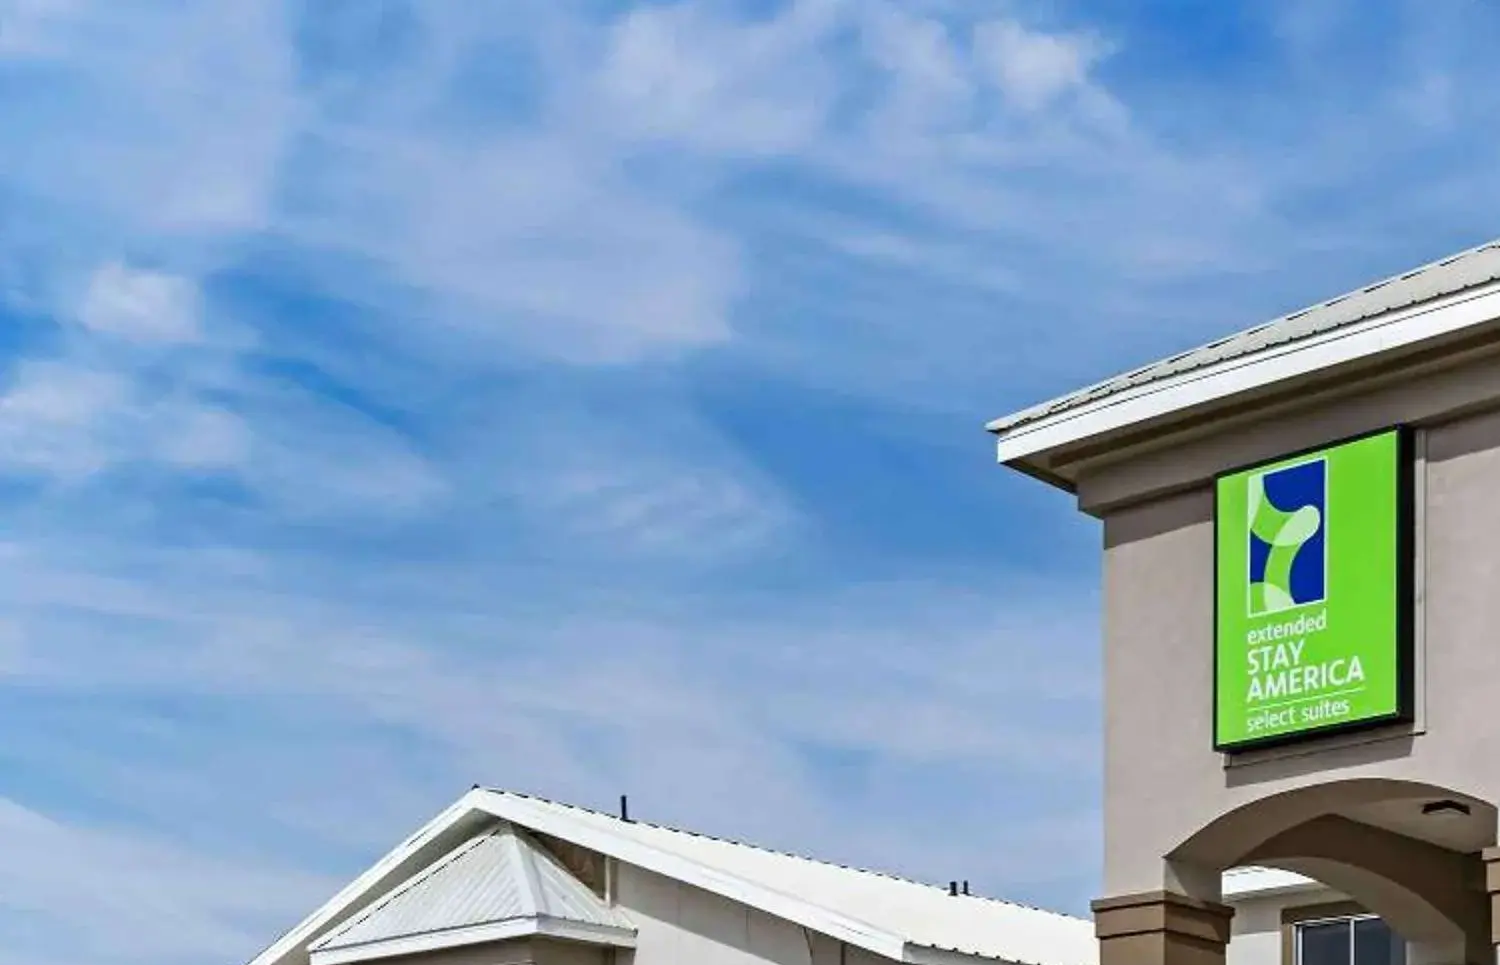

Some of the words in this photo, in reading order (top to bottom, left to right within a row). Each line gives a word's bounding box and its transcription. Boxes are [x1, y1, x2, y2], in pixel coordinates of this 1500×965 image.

[1247, 607, 1327, 644] extended
[1247, 638, 1305, 676] STAY
[1246, 655, 1365, 704] AMERICA
[1247, 706, 1296, 732] select
[1302, 699, 1350, 723] suites
